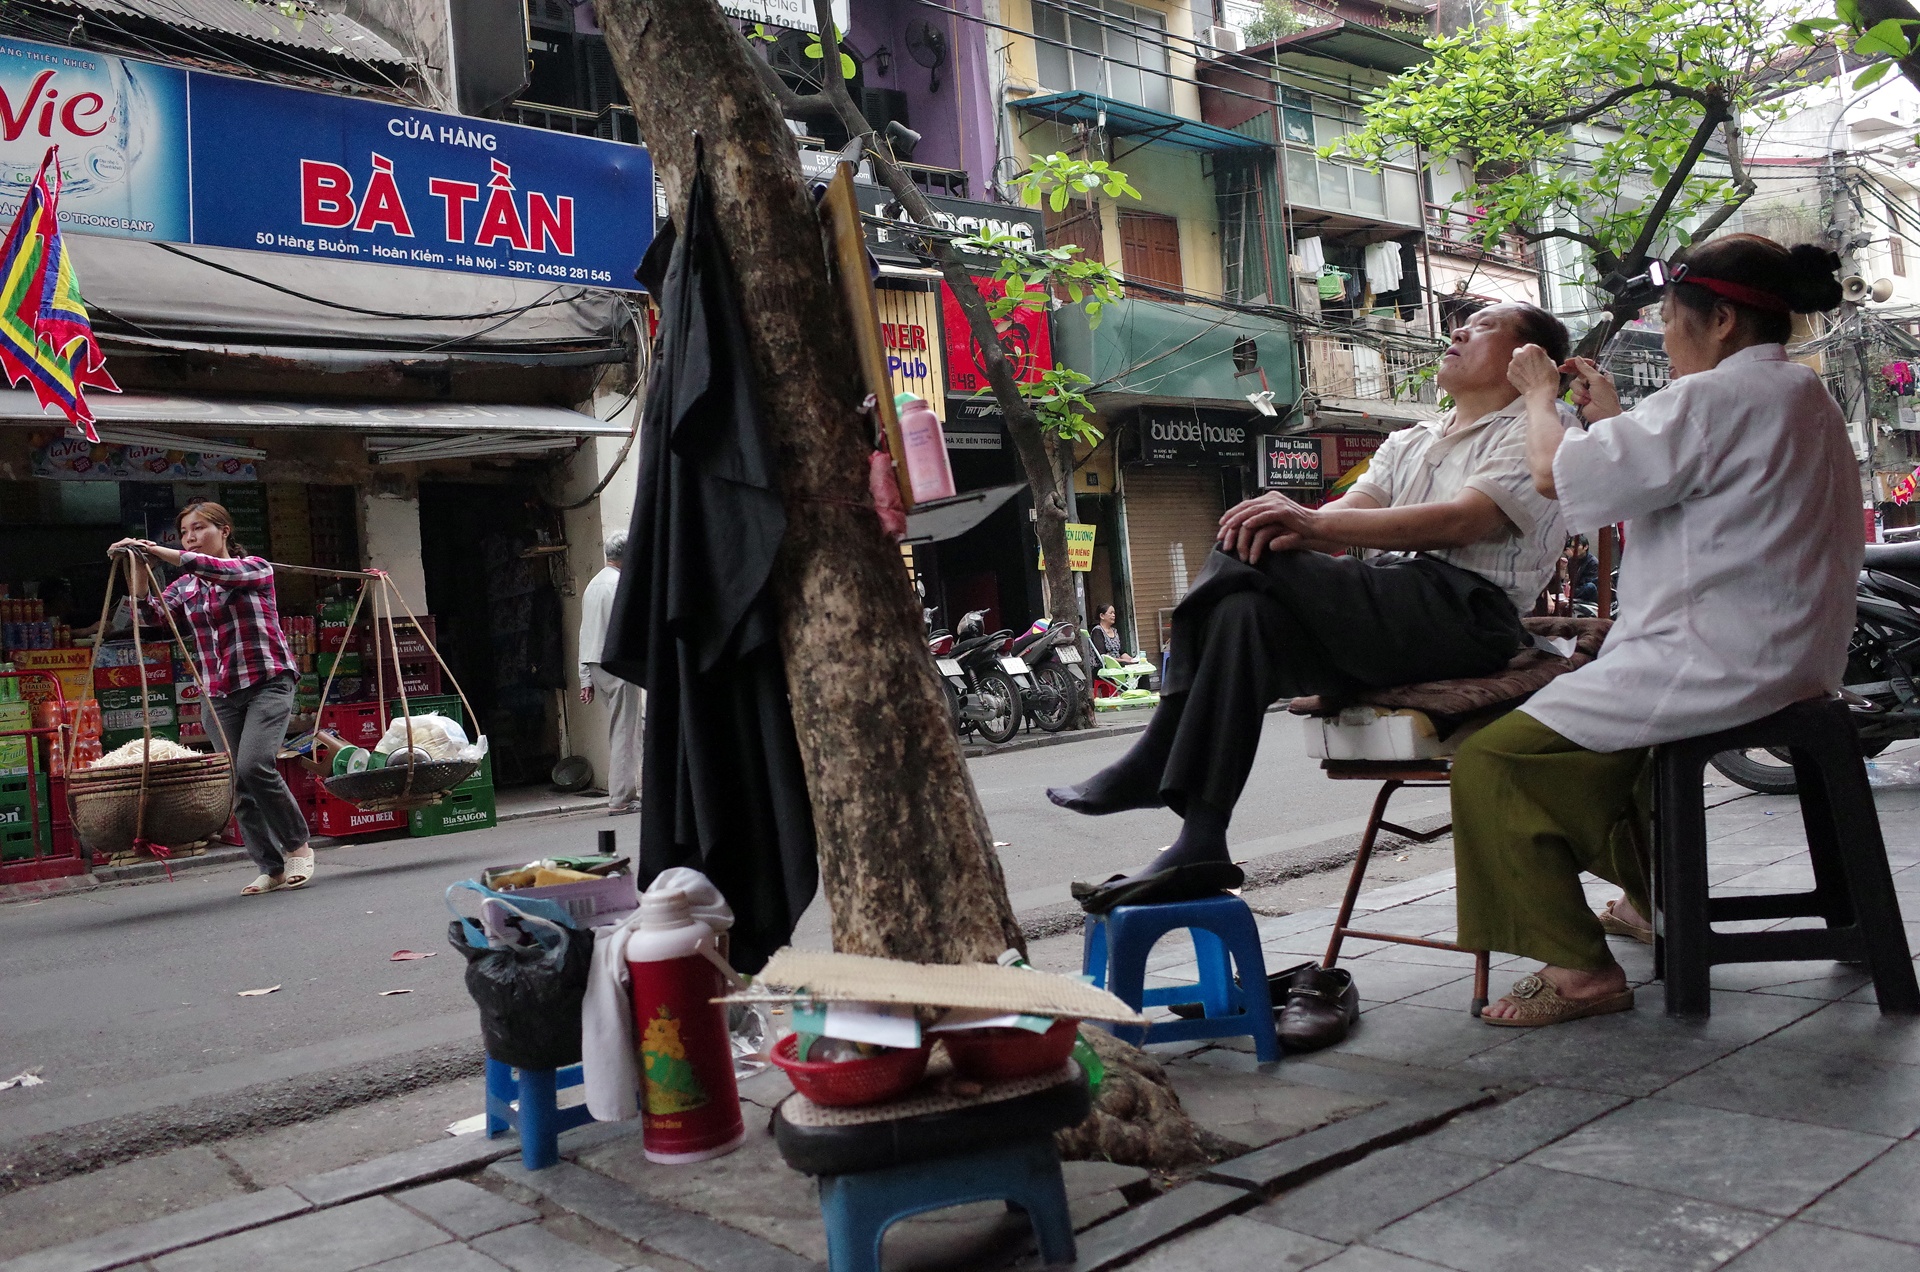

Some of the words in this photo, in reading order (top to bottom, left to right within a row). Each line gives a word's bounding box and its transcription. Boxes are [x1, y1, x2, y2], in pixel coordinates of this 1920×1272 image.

[723, 6, 761, 21] worth
[766, 15, 772, 23] a
[776, 15, 818, 32] fortun
[27, 51, 58, 64] THIÊN
[63, 57, 96, 70] NHIÊN
[387, 117, 435, 142] CỬA
[440, 126, 497, 151] HÀNG
[16, 172, 32, 183] Ca
[62, 170, 72, 180] K
[300, 151, 415, 238] BÀ
[429, 156, 575, 257] TẦN
[72, 212, 119, 228] TRONG
[121, 217, 155, 233] BẠN?
[256, 232, 274, 245] 50
[278, 234, 315, 252] Hàng
[372, 245, 408, 260] Hoàn
[456, 254, 473, 266] Hà
[476, 255, 497, 271] Nội
[508, 261, 535, 274] SĐT:
[538, 263, 567, 277] 0438
[570, 266, 588, 279] 281
[591, 269, 612, 282] 545
[881, 323, 927, 350] NER
[888, 356, 927, 378] Pub
[958, 374, 977, 389] 48
[1151, 419, 1200, 441] bubble
[1203, 422, 1245, 444] house
[1344, 438, 1360, 447] THU
[1269, 451, 1319, 469] TATTOO
[1076, 560, 1088, 568] NAM
[414, 644, 425, 652] NỘI
[31, 655, 50, 665] BIA
[51, 653, 67, 664] HÀ
[67, 652, 86, 664] NỘI
[408, 684, 417, 692] HÀ
[418, 683, 429, 692] NỘI
[130, 693, 169, 704] SPCIAL
[350, 815, 375, 826] HANOI
[376, 811, 395, 822] BEER
[457, 811, 487, 822] SAIGON
